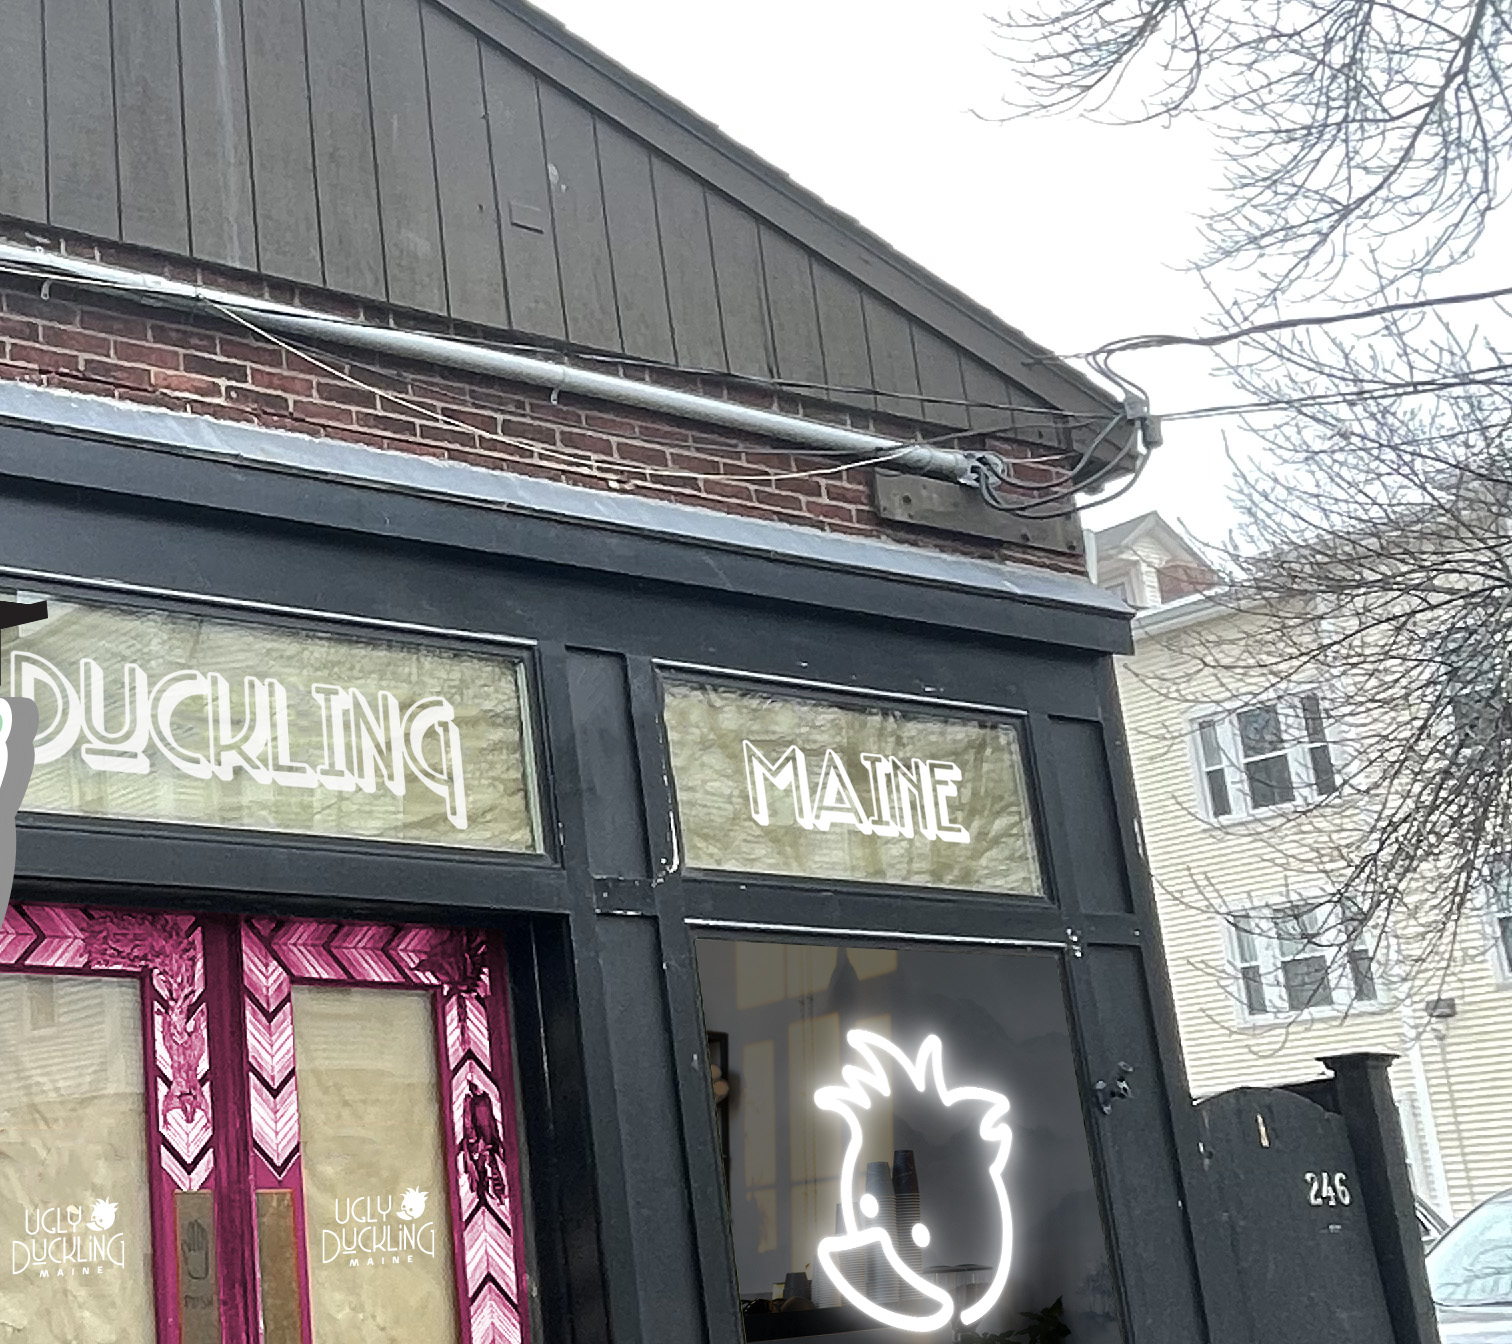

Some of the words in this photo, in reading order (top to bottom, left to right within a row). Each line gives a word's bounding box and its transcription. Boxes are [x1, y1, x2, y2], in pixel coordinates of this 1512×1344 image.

[11, 650, 468, 829] DUCKLING
[742, 739, 971, 843] MAINE
[1304, 1172, 1350, 1206] 246
[25, 1205, 82, 1235] UGLY
[335, 1194, 392, 1224] UGLY
[39, 1266, 104, 1278] MAINE
[349, 1255, 414, 1267] MAINE
